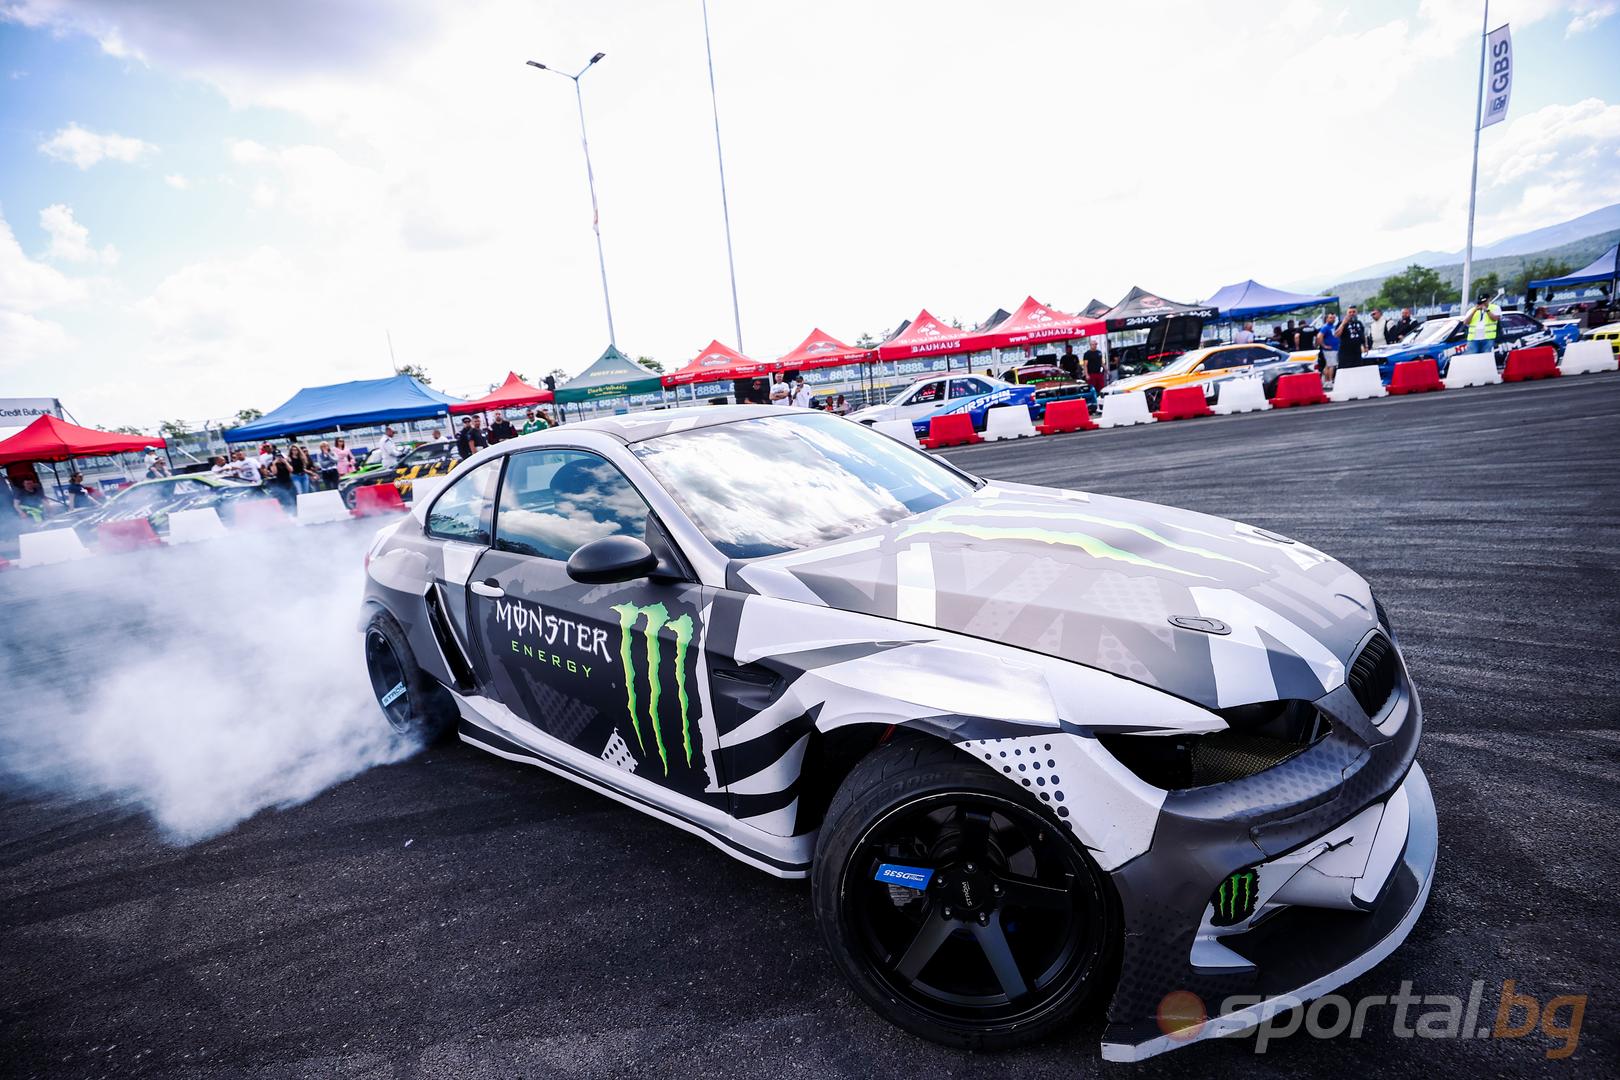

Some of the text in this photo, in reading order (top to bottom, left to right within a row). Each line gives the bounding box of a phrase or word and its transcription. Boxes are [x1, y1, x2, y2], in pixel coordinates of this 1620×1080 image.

[1492, 40, 1510, 93] GBS
[1126, 315, 1160, 326] 24MX
[911, 340, 961, 353] BAUHAUS
[495, 600, 612, 663] MONSTER
[511, 640, 592, 678] ENERGY
